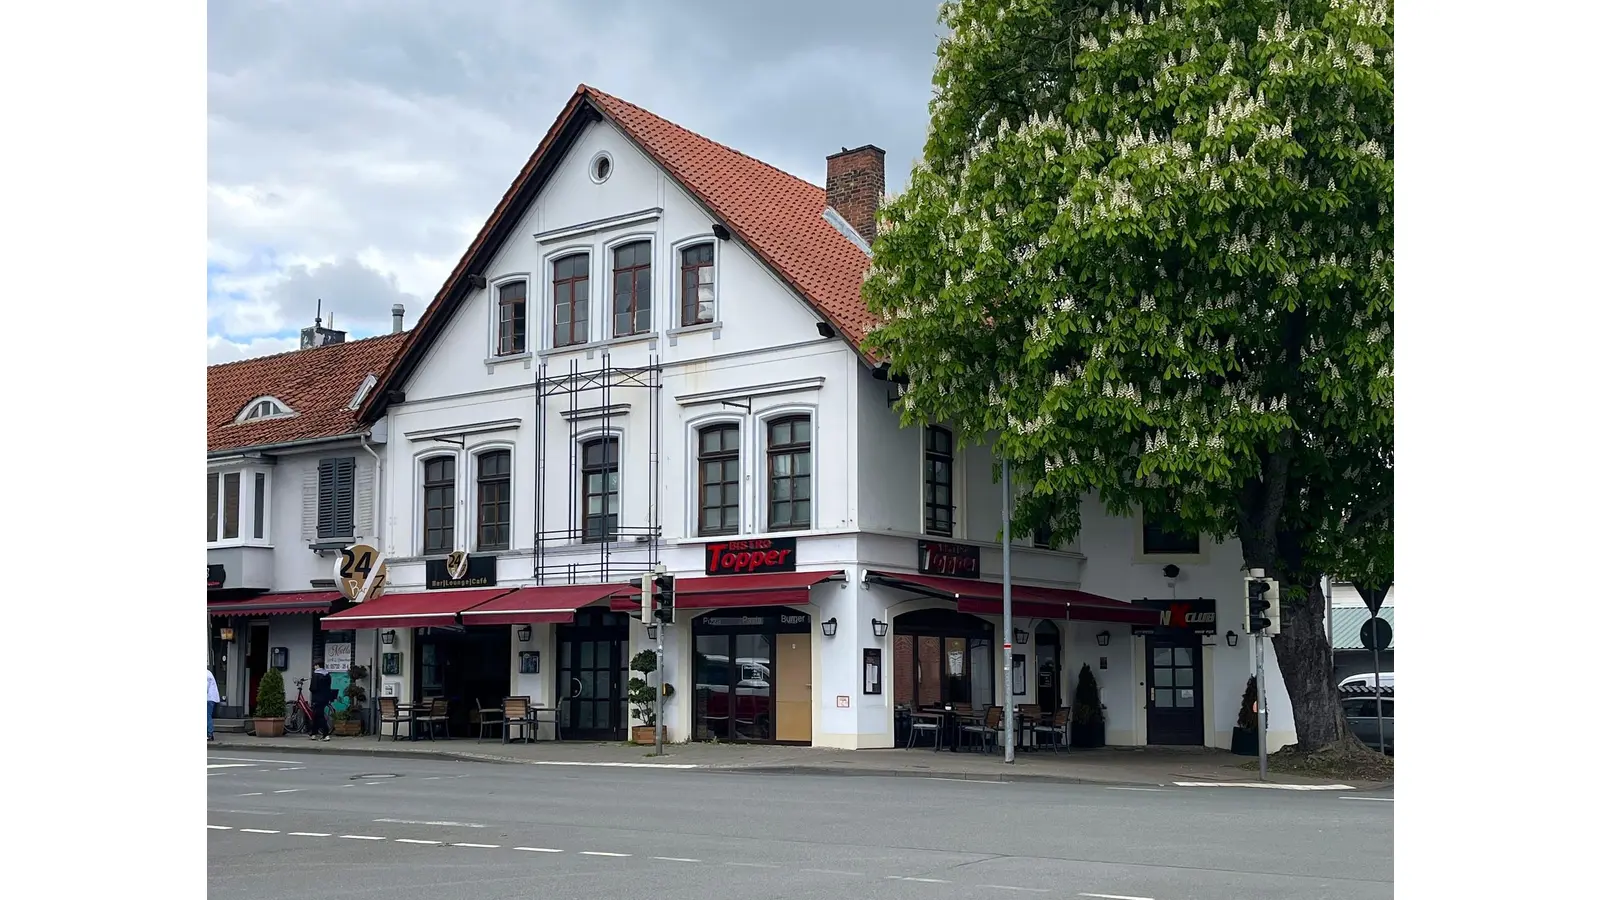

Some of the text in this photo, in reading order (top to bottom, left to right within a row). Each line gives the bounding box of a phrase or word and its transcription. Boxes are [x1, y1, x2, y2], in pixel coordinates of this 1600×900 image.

[729, 540, 773, 550] BISTRO
[708, 544, 792, 573] Topper
[780, 613, 806, 625] Burger
[1184, 612, 1216, 623] CLUB
